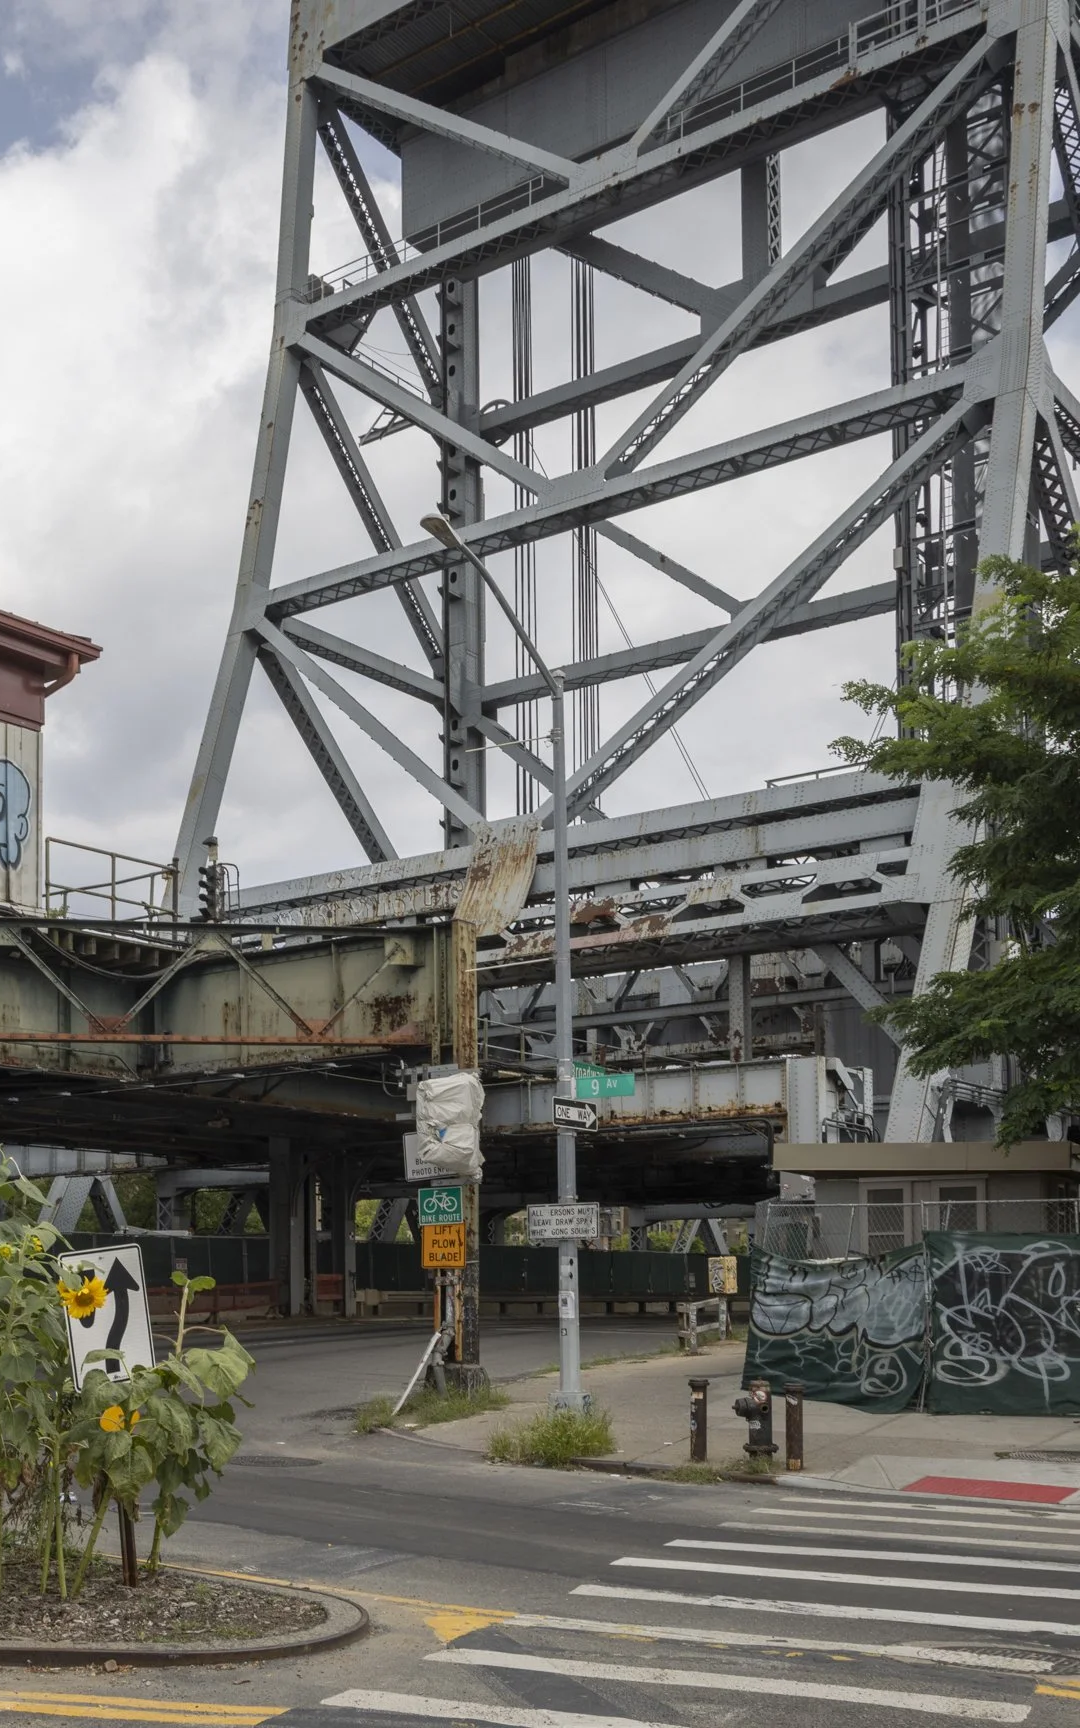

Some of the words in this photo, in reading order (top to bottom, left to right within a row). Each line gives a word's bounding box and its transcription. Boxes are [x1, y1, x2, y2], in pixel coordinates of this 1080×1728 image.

[591, 1079, 600, 1096] 9
[556, 1106, 571, 1118] ONE
[577, 1110, 591, 1121] WAY
[415, 1158, 428, 1166] BU
[411, 1167, 432, 1176] PHOTO
[531, 1209, 544, 1217] ALL
[548, 1208, 575, 1217] ERSONS
[421, 1215, 436, 1223] BIKE
[439, 1213, 461, 1222] ROUTE
[533, 1219, 552, 1227] LEAVE
[555, 1218, 573, 1226] DRAW
[434, 1225, 453, 1235] LIFT
[531, 1228, 547, 1236] WHE
[551, 1227, 569, 1236] GONG
[432, 1239, 456, 1249] PLOW
[428, 1252, 459, 1262] BLADE
